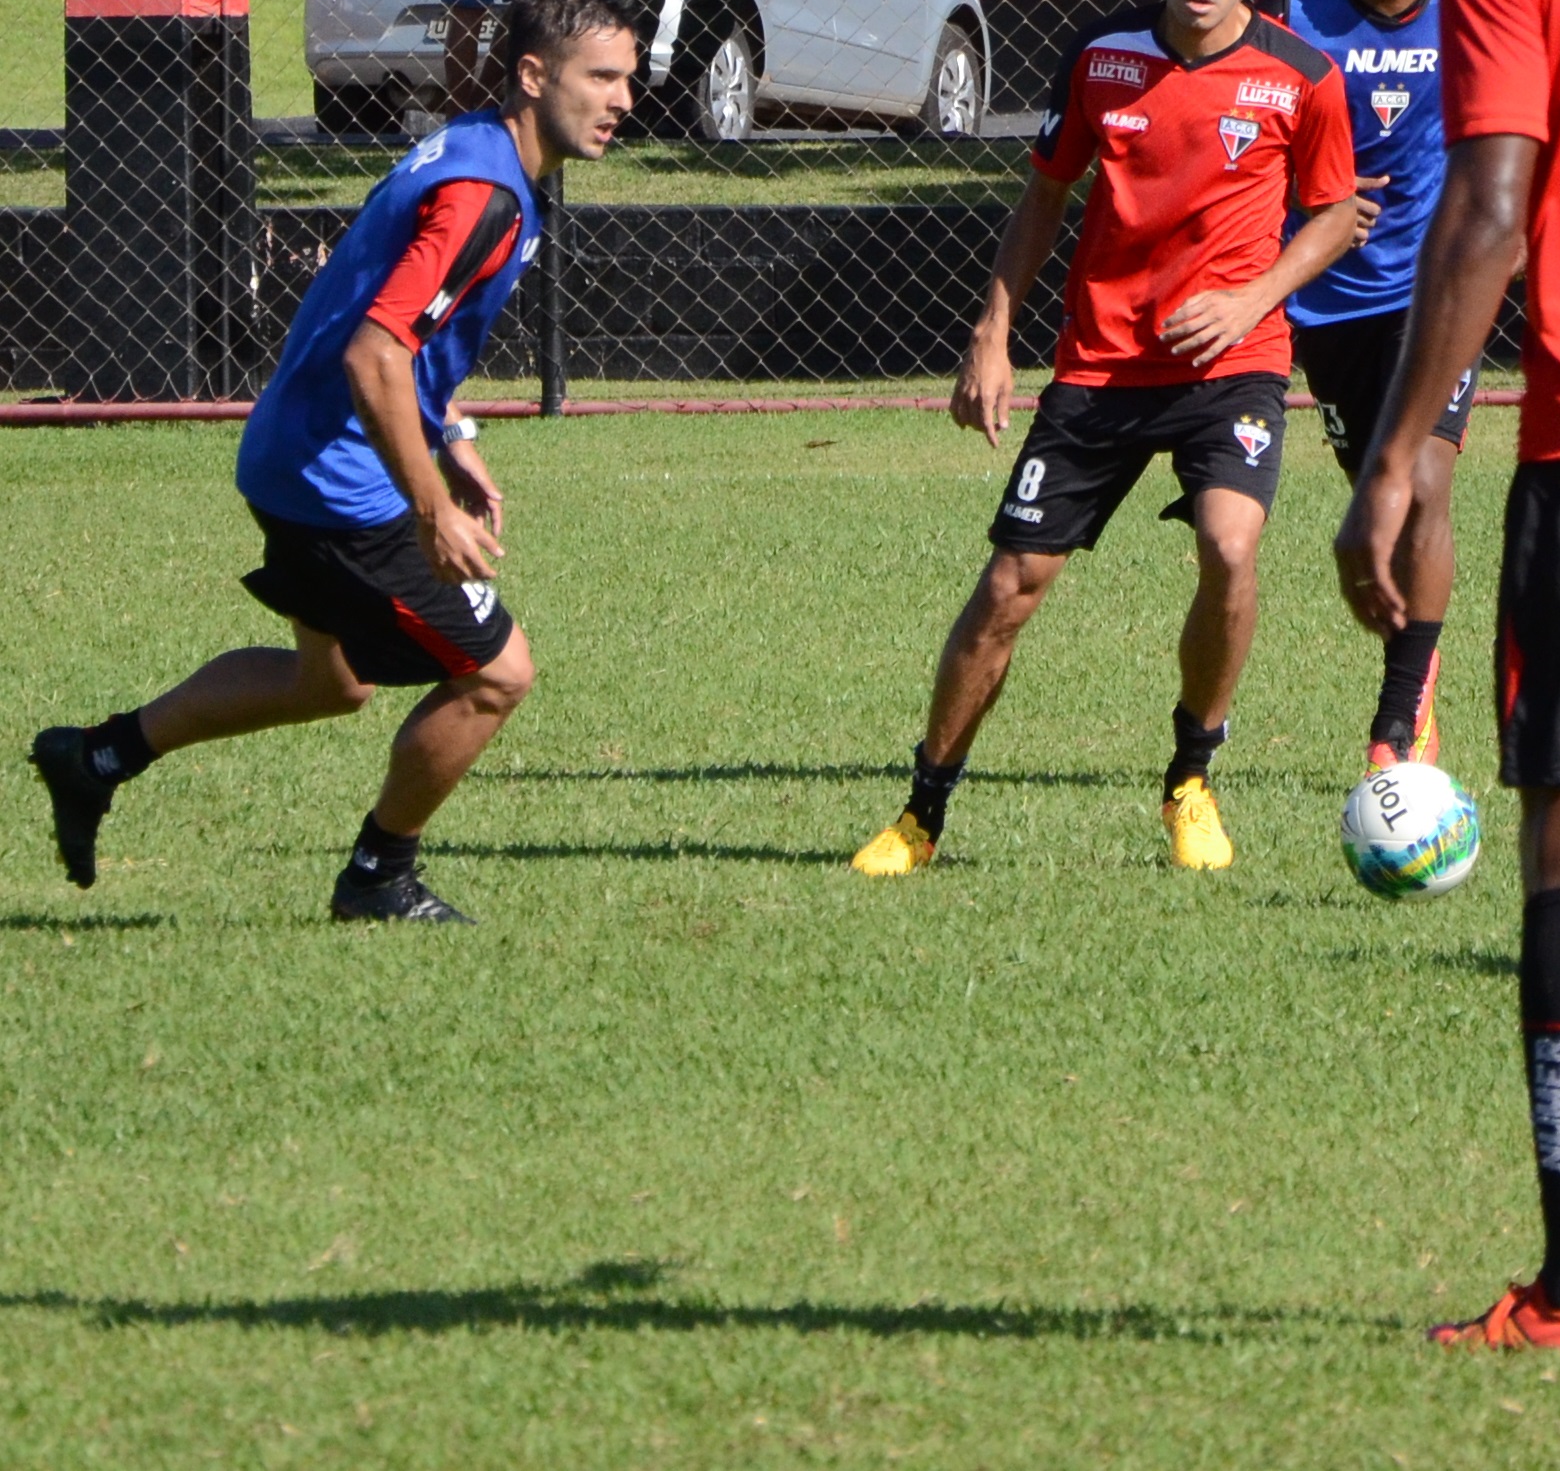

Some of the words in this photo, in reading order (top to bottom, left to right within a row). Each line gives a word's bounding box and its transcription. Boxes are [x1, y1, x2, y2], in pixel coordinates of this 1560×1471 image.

[1089, 62, 1142, 84] LUZTOL
[1345, 49, 1438, 74] NUMER
[1240, 86, 1294, 110] LUZTOL
[1103, 112, 1149, 131] NUMER
[1017, 458, 1046, 502] 8
[1003, 503, 1044, 524] NUMER
